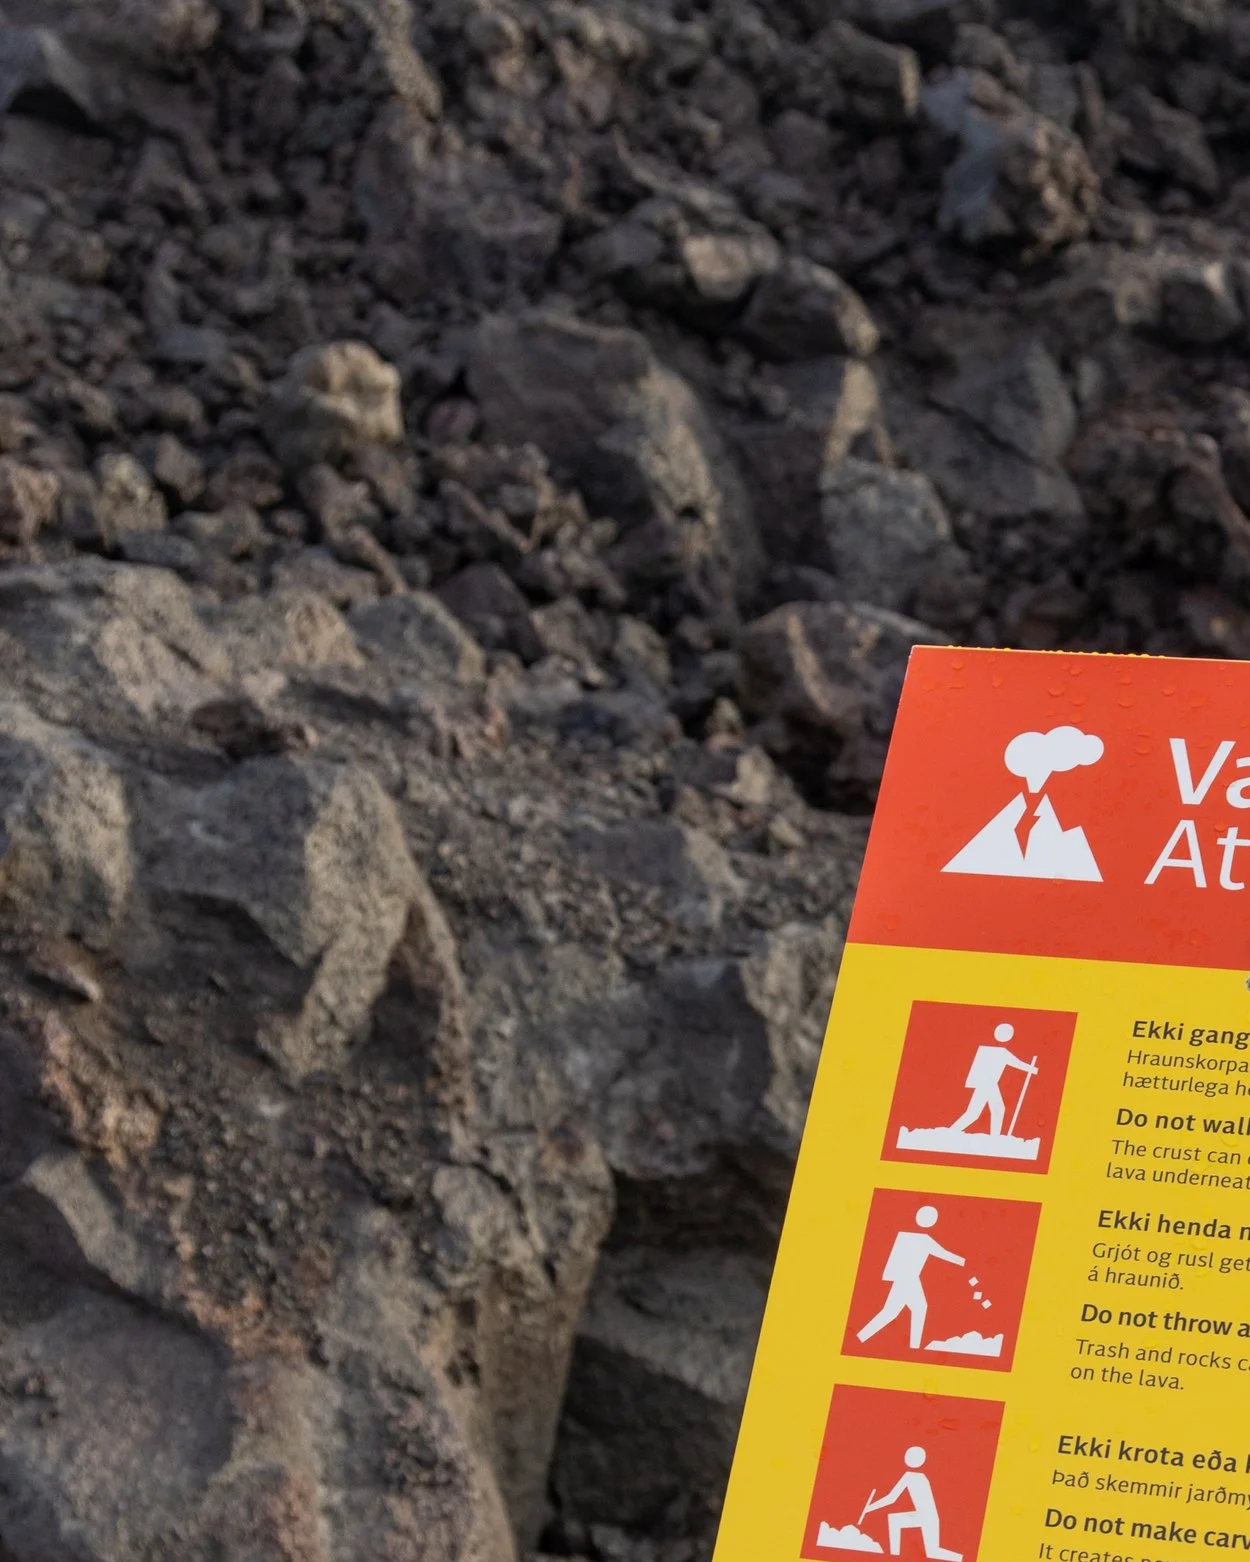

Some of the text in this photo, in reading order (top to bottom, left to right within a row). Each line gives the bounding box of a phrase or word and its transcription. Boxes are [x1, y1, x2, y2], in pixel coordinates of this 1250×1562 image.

[1132, 1020, 1185, 1041] Ekki
[1122, 1071, 1229, 1098] hætturlega
[1115, 1107, 1149, 1128] Do
[1154, 1114, 1197, 1132] not
[1111, 1139, 1147, 1158] The
[1152, 1146, 1202, 1162] crust
[1207, 1150, 1242, 1165] can
[1106, 1161, 1146, 1182] lava
[1097, 1209, 1151, 1232] Ekki
[1156, 1213, 1232, 1240] henda
[1092, 1242, 1142, 1263] Grjót
[1146, 1250, 1173, 1269] og
[1177, 1251, 1214, 1269] rusl
[1087, 1264, 1184, 1291] á hraunið.
[1080, 1303, 1113, 1325] Do
[1117, 1311, 1159, 1329] not
[1162, 1311, 1234, 1336] throw
[1075, 1338, 1130, 1360] Trash
[1134, 1346, 1173, 1364] and
[1177, 1350, 1232, 1370] rocks
[1070, 1365, 1184, 1391] on the lava.
[1057, 1434, 1112, 1459] Ekki
[1117, 1439, 1185, 1468] krota
[1192, 1449, 1237, 1473] eða
[1051, 1469, 1090, 1489] Það
[1095, 1473, 1183, 1499] skemmir
[1044, 1508, 1078, 1531] Do
[1083, 1516, 1126, 1536] not
[1130, 1520, 1198, 1545] make
[1038, 1542, 1054, 1561] It
